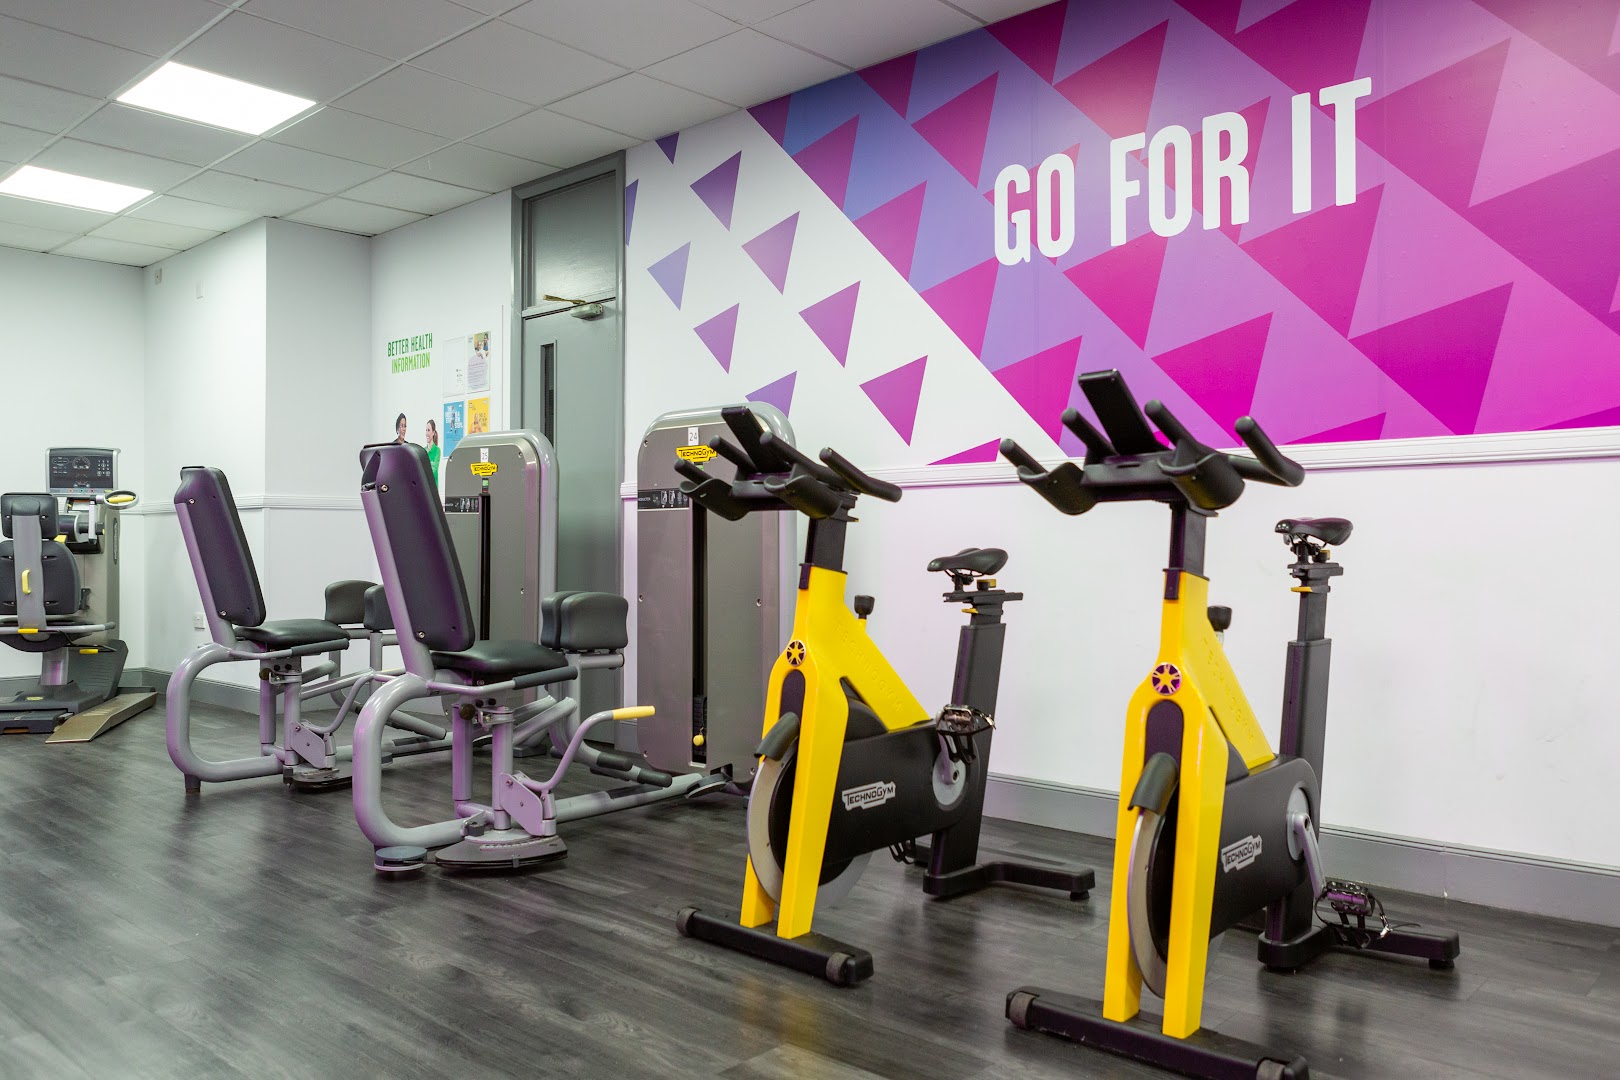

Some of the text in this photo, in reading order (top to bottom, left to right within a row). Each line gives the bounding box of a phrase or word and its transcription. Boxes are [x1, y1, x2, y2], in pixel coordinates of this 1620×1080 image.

[994, 76, 1372, 266] GO FOR IT
[387, 332, 433, 357] BETTER HEALTH
[391, 351, 431, 374] INFORMATION
[689, 432, 698, 441] 24
[843, 785, 894, 806] TECHNOGYM
[1222, 840, 1261, 867] TECHNOGYM
